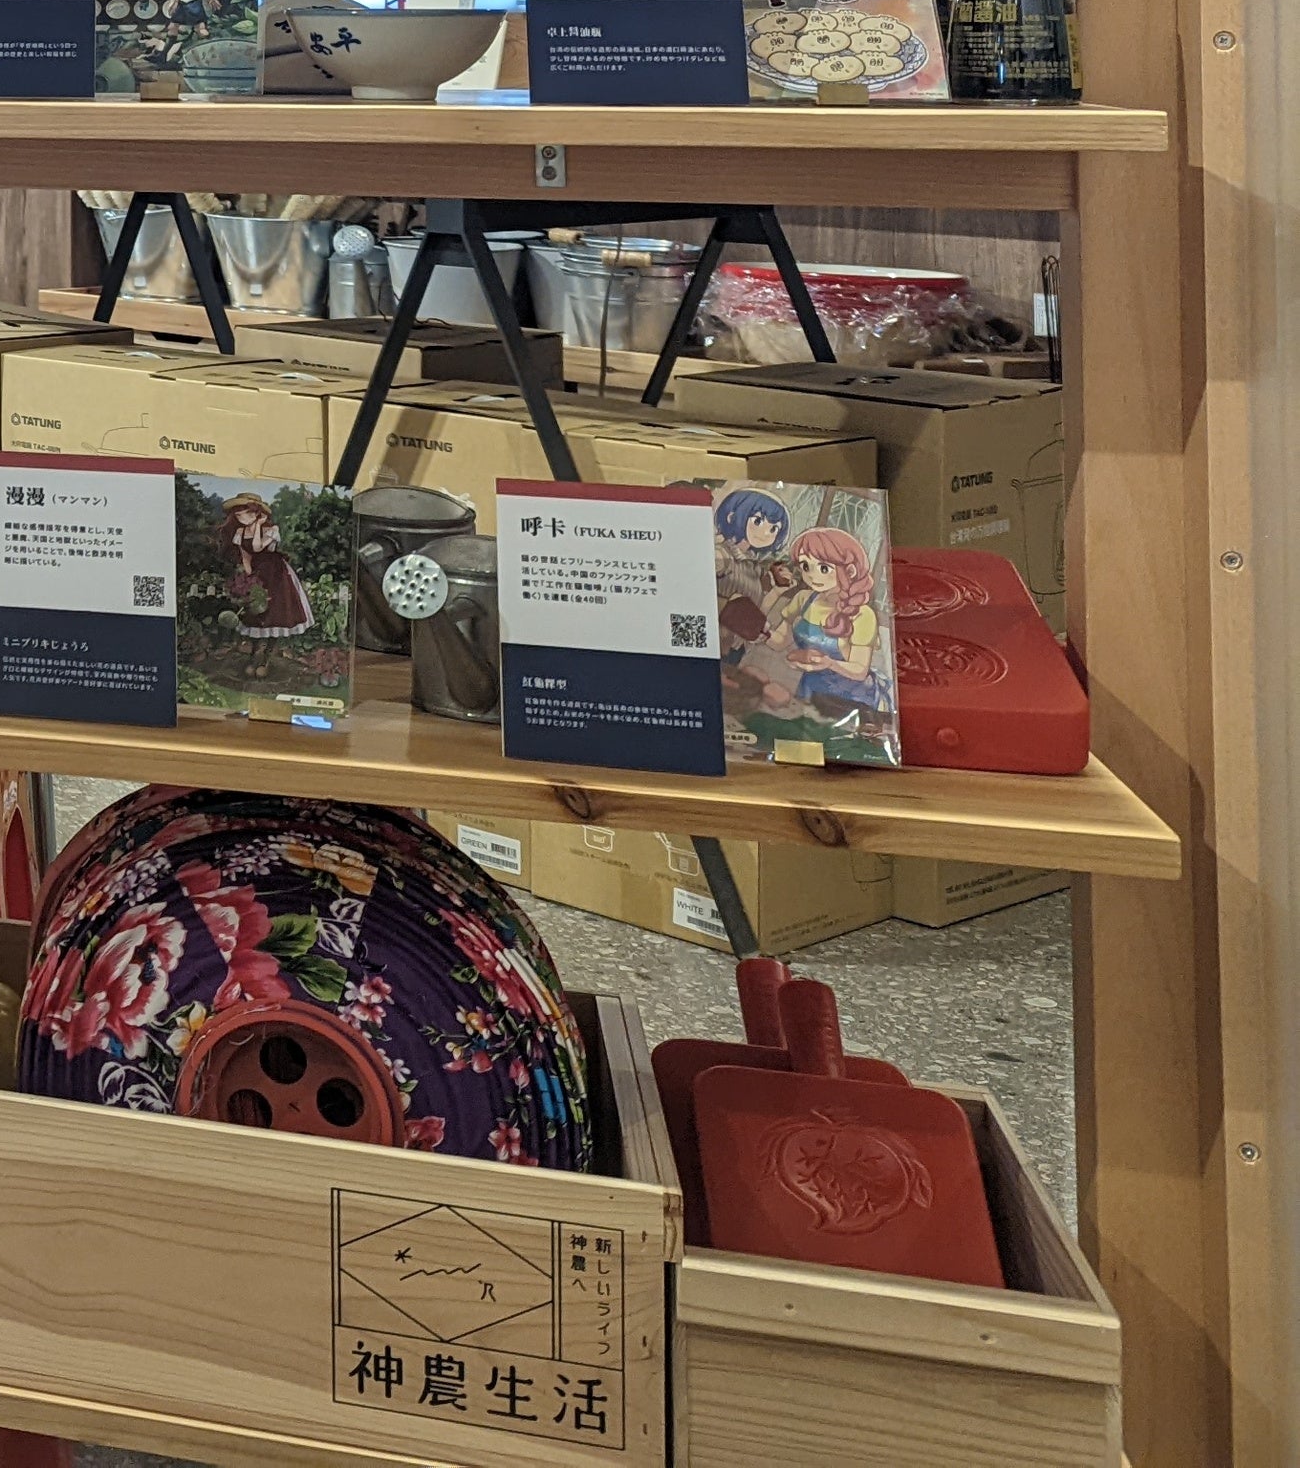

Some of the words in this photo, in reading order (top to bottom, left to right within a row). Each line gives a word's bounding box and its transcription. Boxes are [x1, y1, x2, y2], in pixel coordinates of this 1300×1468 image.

[21, 415, 62, 430] TATUNG
[171, 438, 216, 455] TATUNG
[400, 437, 454, 453] TATUNG
[960, 471, 994, 488] TATUNG
[5, 486, 46, 508] 漫漫
[520, 515, 566, 538] 呼卡
[573, 526, 617, 540] (FUKA
[618, 527, 664, 543] SHEU)
[2, 637, 90, 652] ミニブリキじょうろ
[460, 836, 489, 851] GREEN
[676, 899, 705, 917] WHITE
[569, 1232, 588, 1292] 神農へ
[594, 1236, 613, 1357] 新しいライフ
[349, 1340, 608, 1435] 神農生活
